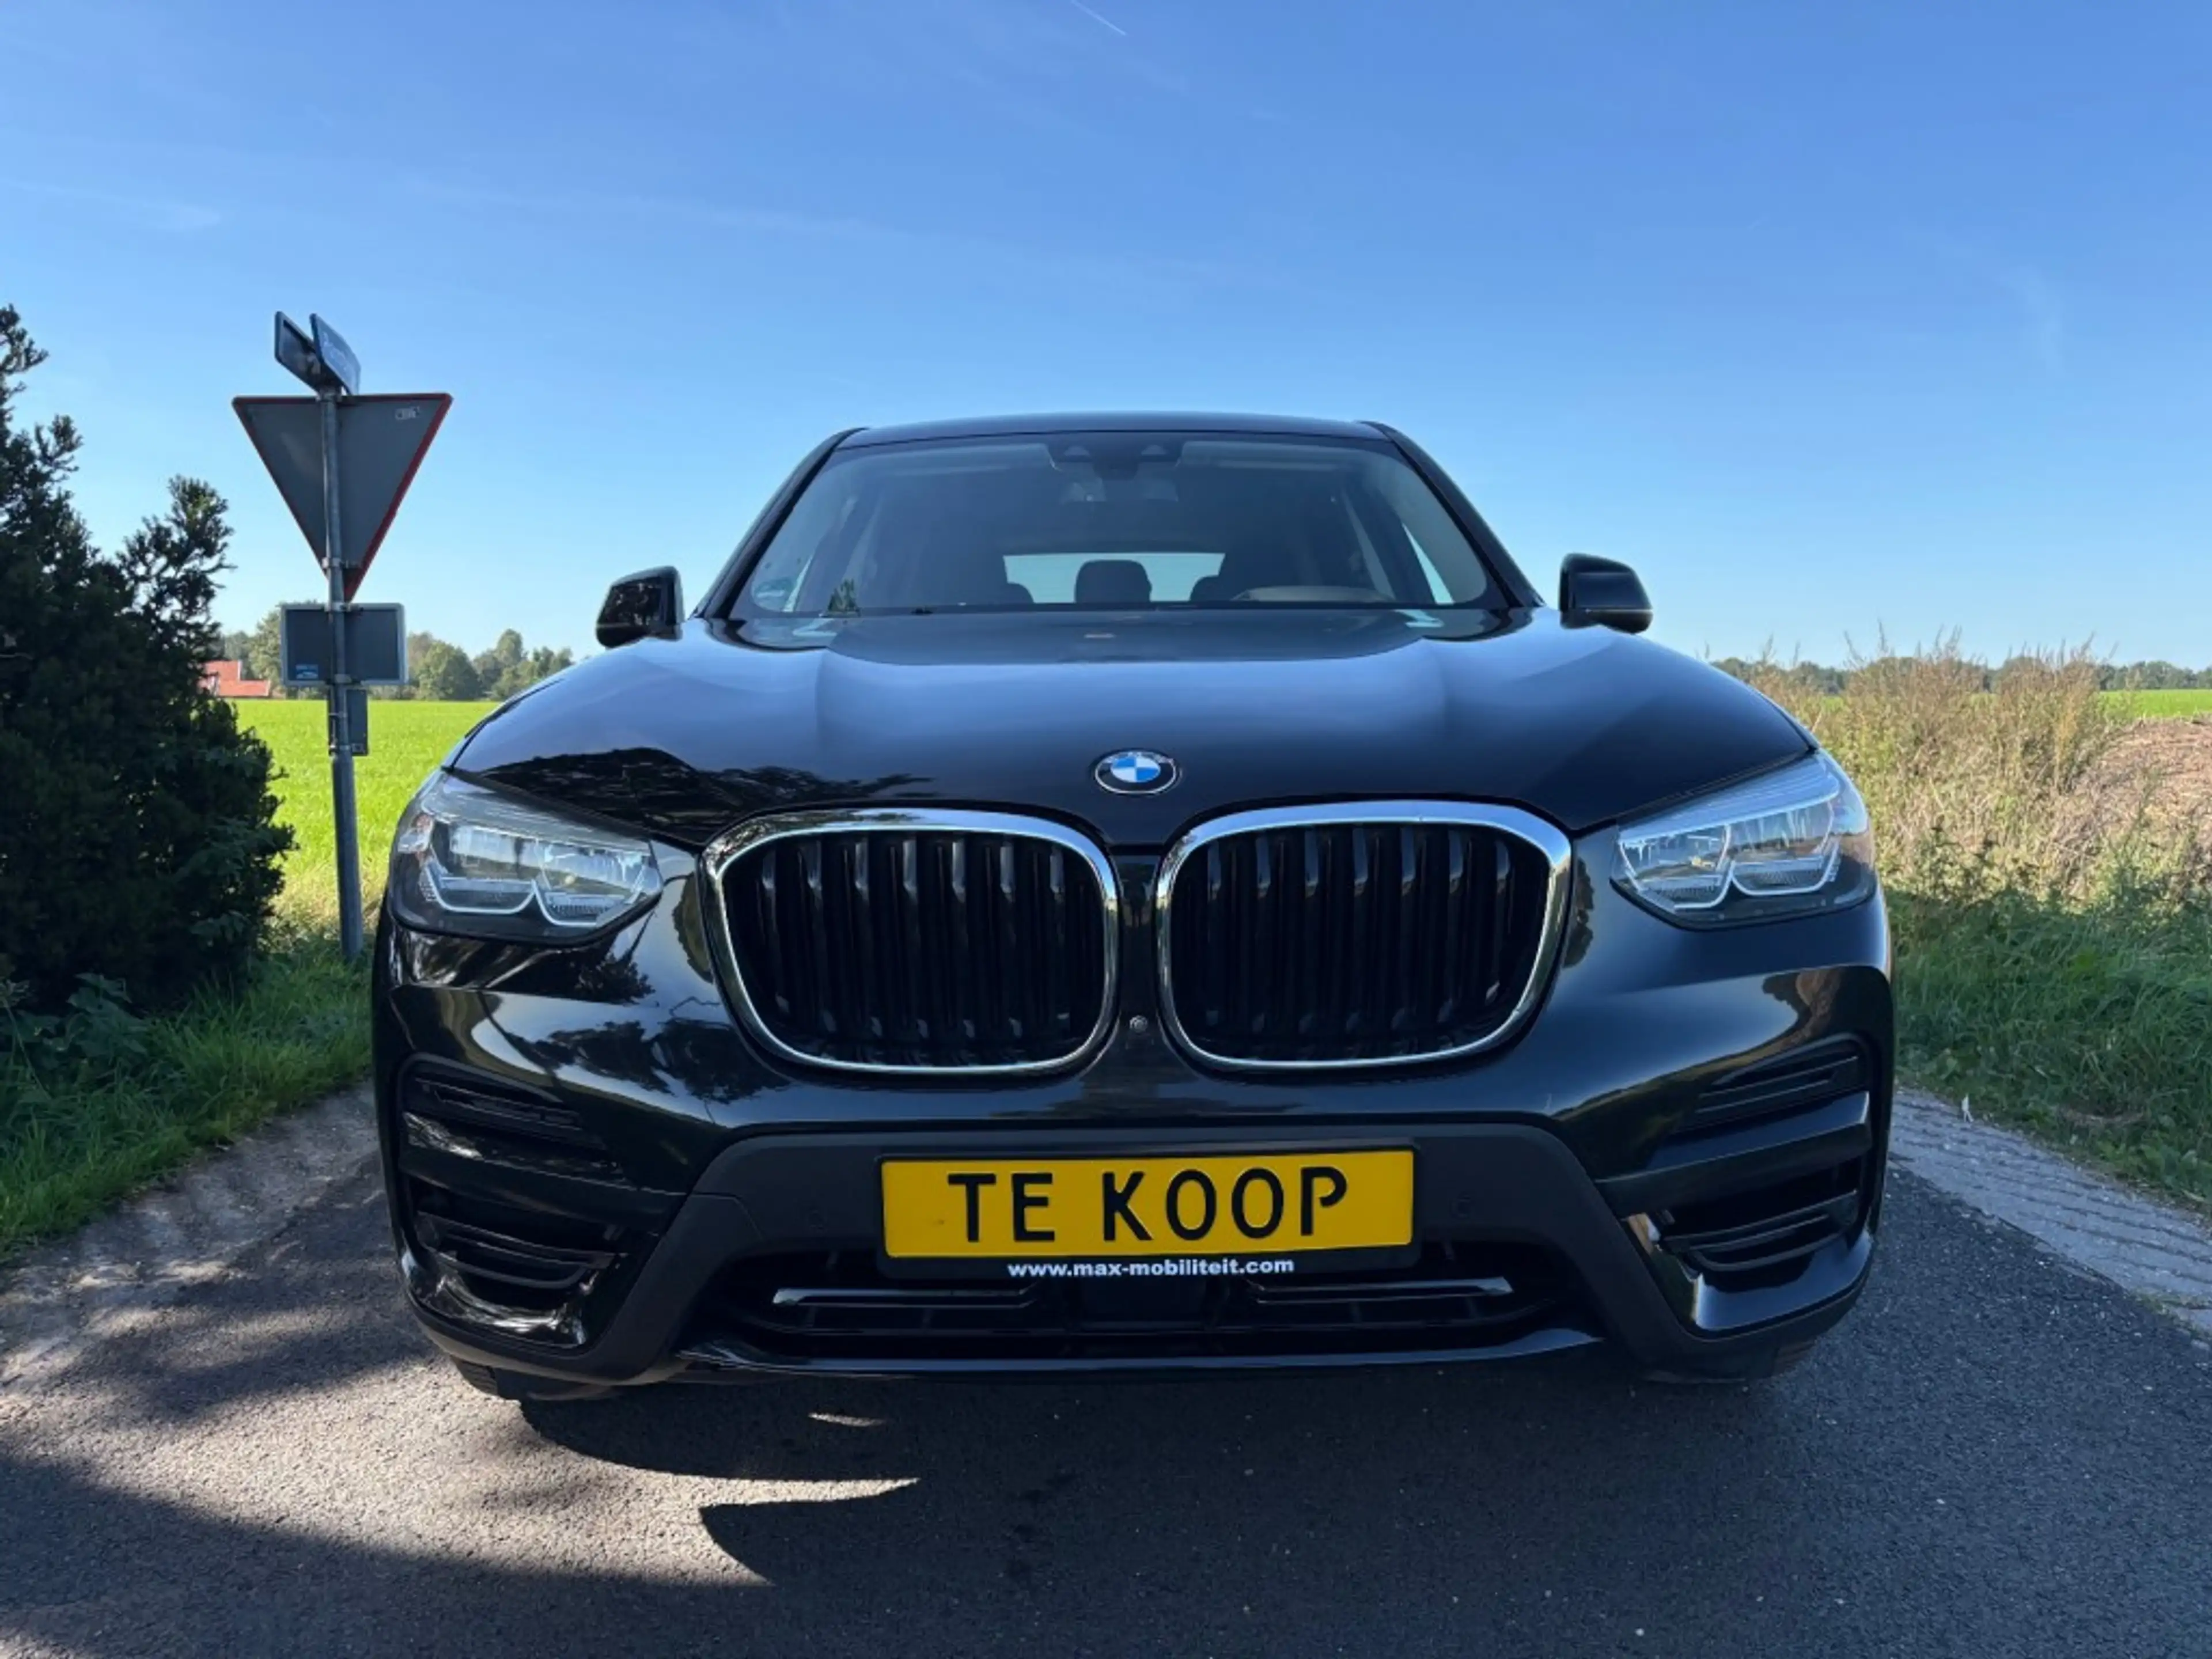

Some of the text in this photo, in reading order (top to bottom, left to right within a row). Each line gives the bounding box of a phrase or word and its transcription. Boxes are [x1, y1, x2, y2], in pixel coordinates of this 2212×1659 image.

[947, 1166, 1347, 1242] TE KOOP
[1007, 1258, 1294, 1277] www.max-mobiliteit.com
